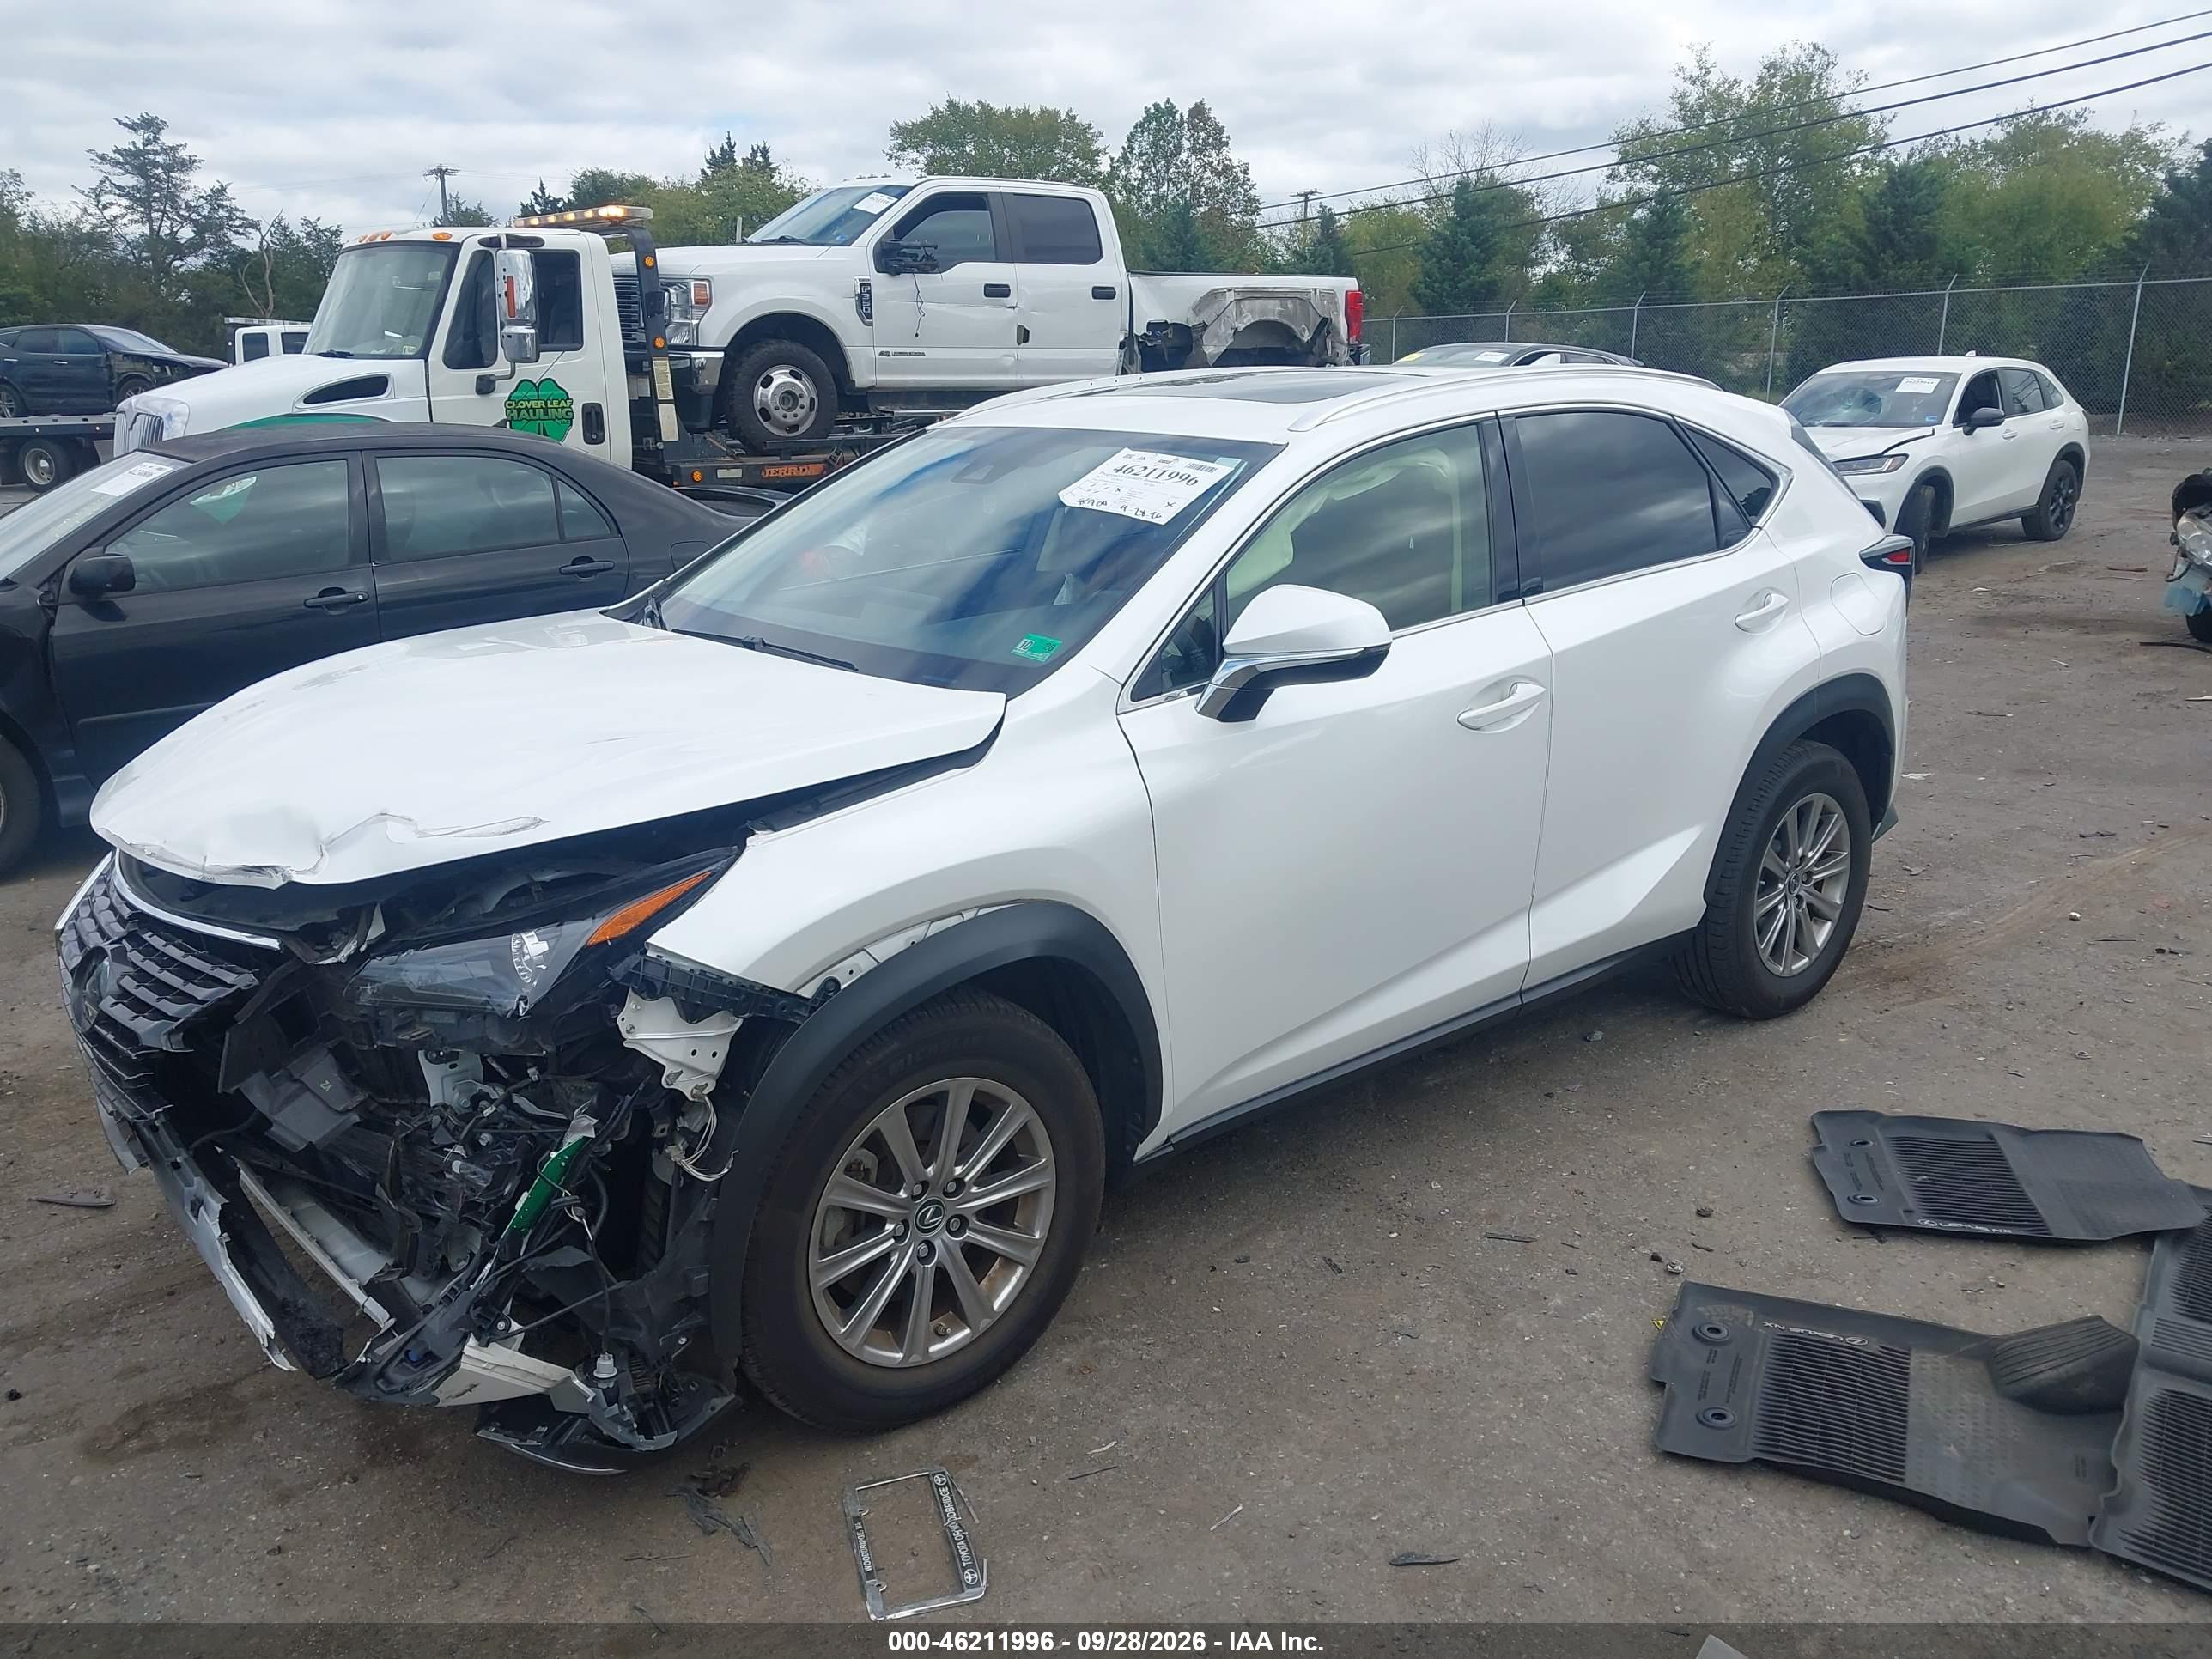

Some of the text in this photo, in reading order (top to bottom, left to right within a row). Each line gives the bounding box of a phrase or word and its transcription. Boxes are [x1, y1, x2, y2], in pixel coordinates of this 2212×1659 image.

[505, 399, 573, 409] CLOVER LEAF
[506, 408, 574, 420] HAULING
[1113, 463, 1202, 487] 46211996
[1018, 640, 1034, 651] 10
[1043, 642, 1056, 652] 26
[957, 1541, 974, 1567] TOYOTA
